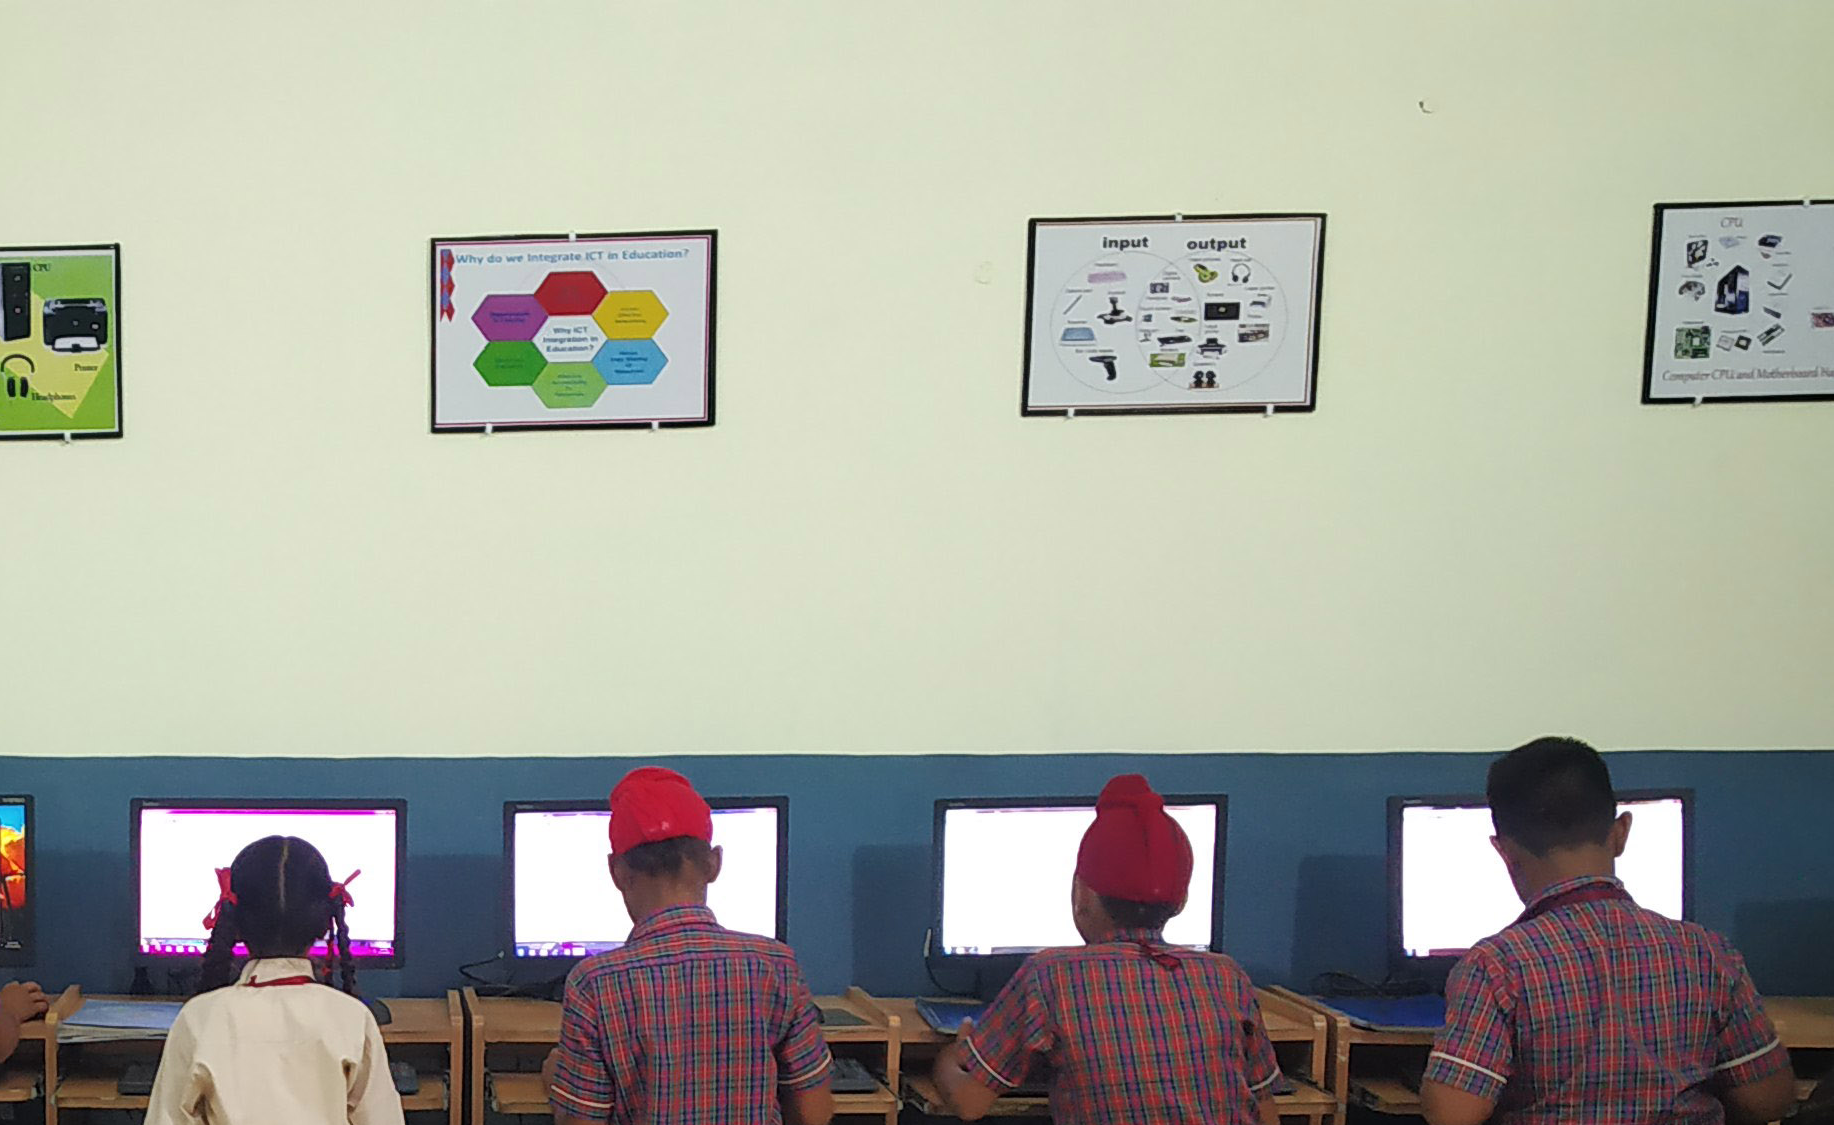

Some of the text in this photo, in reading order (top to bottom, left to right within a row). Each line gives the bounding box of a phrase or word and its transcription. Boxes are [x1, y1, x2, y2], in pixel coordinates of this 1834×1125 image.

[1720, 216, 1744, 228] CPU
[1102, 236, 1149, 251] input
[1186, 237, 1247, 252] output
[455, 248, 690, 265] Why do we Integrate ICT in Education?
[33, 263, 51, 272] CPU
[573, 326, 587, 334] ICT
[542, 336, 589, 344] Integration
[546, 344, 594, 353] Education?
[1662, 370, 1711, 384] Computer
[1711, 368, 1735, 380] CPU
[1736, 367, 1754, 379] and
[1756, 365, 1819, 379] Motherboard
[31, 392, 77, 402] Headphones
